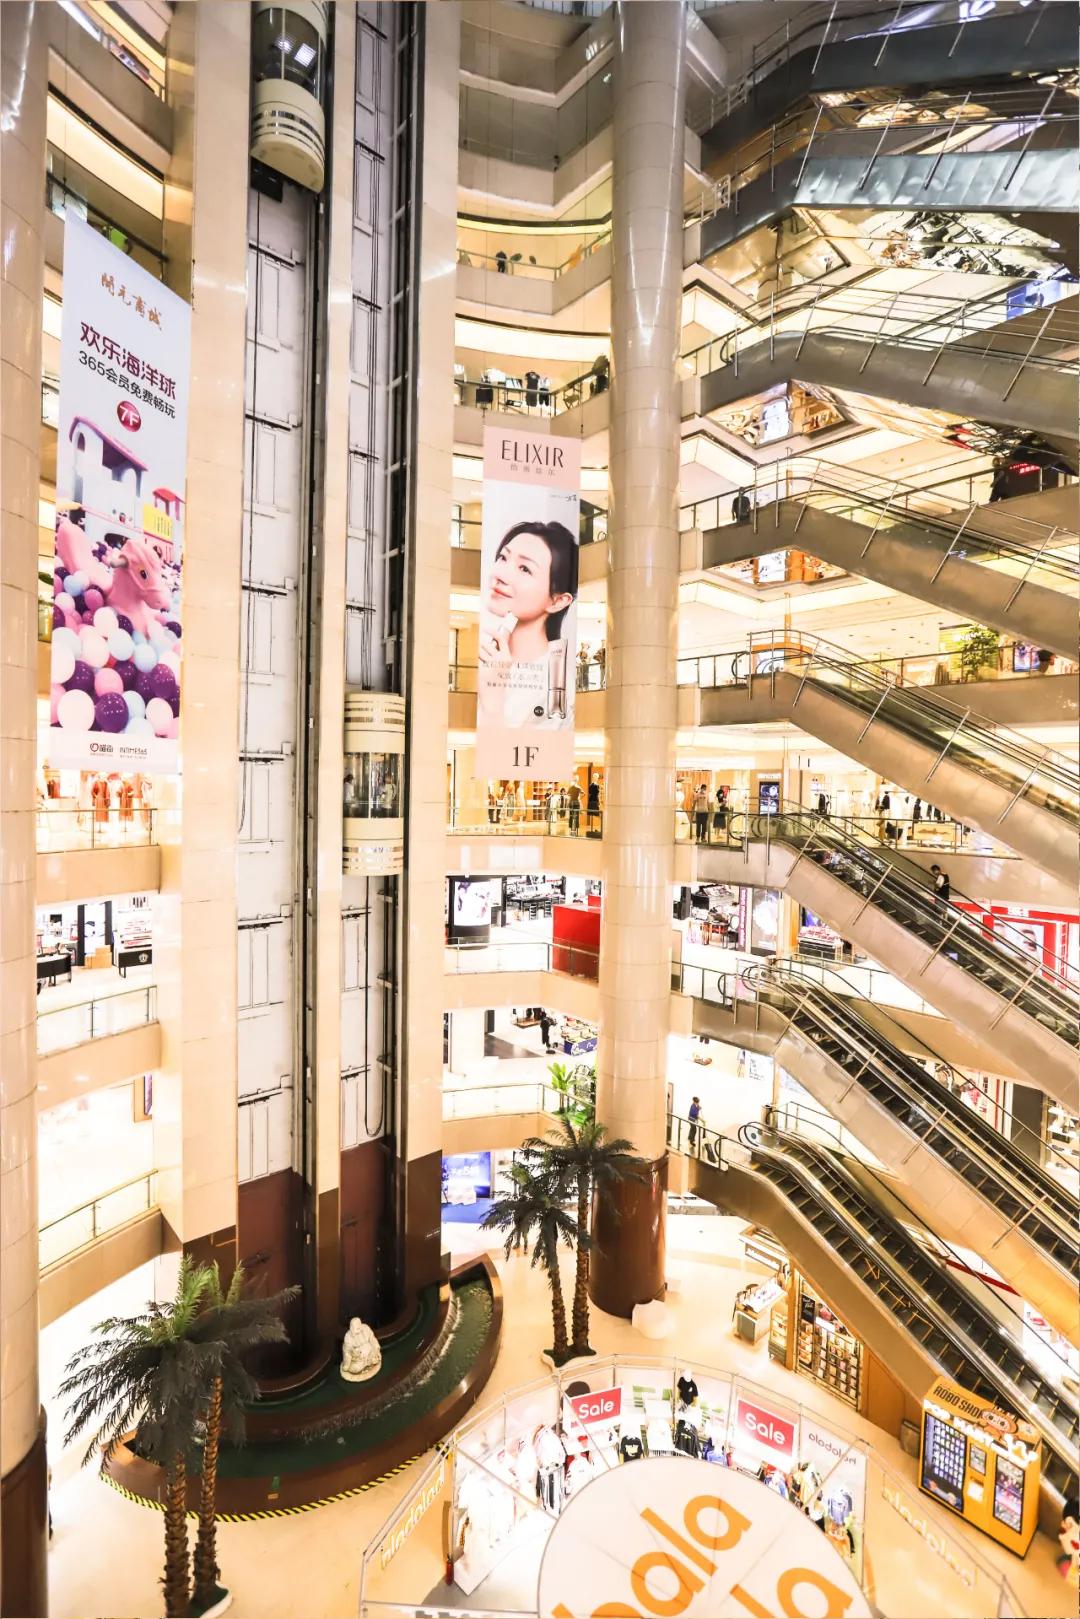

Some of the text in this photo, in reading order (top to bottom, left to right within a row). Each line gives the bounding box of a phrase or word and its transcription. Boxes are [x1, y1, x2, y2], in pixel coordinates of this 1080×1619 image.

[80, 321, 176, 400] 欢乐海洋球
[79, 350, 176, 419] 365会员免费畅玩
[119, 404, 141, 426] 7F
[501, 439, 564, 468] ELIXIR
[512, 745, 539, 767] 1F
[578, 1399, 615, 1420] Sale
[933, 1385, 960, 1409] ROBO
[744, 1412, 787, 1446] Sale
